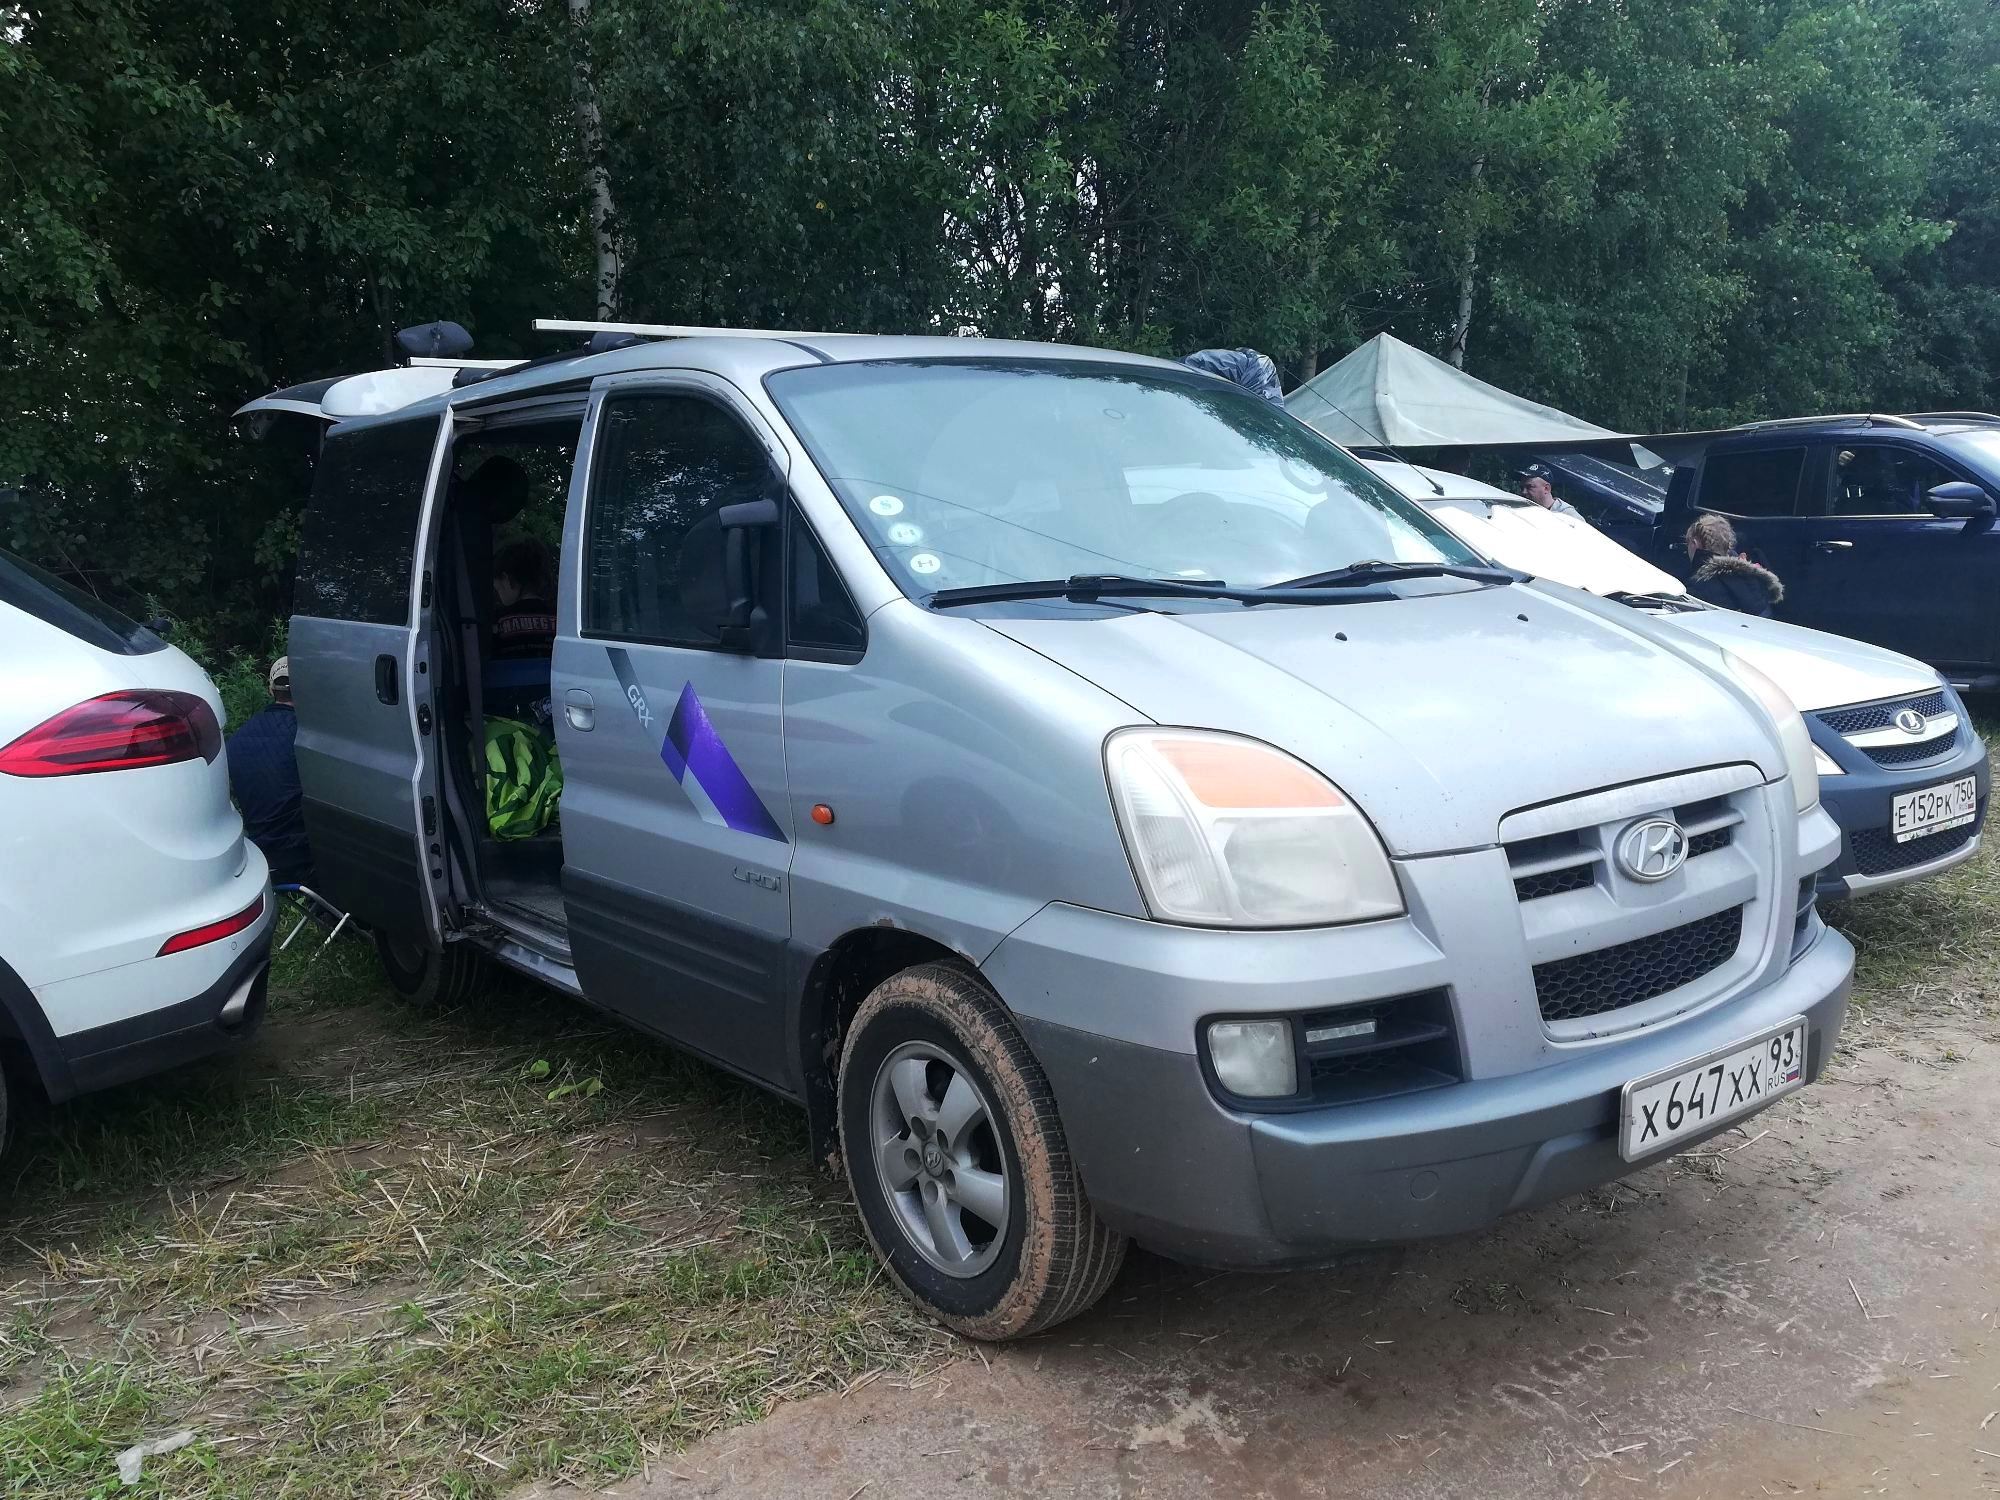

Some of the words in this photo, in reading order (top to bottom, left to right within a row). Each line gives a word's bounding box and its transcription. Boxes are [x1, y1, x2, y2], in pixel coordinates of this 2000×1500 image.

[627, 684, 655, 729] GRX
[1955, 780, 1974, 804] 750
[1770, 1030, 1794, 1074] 93
[1767, 1073, 1786, 1091] RUS
